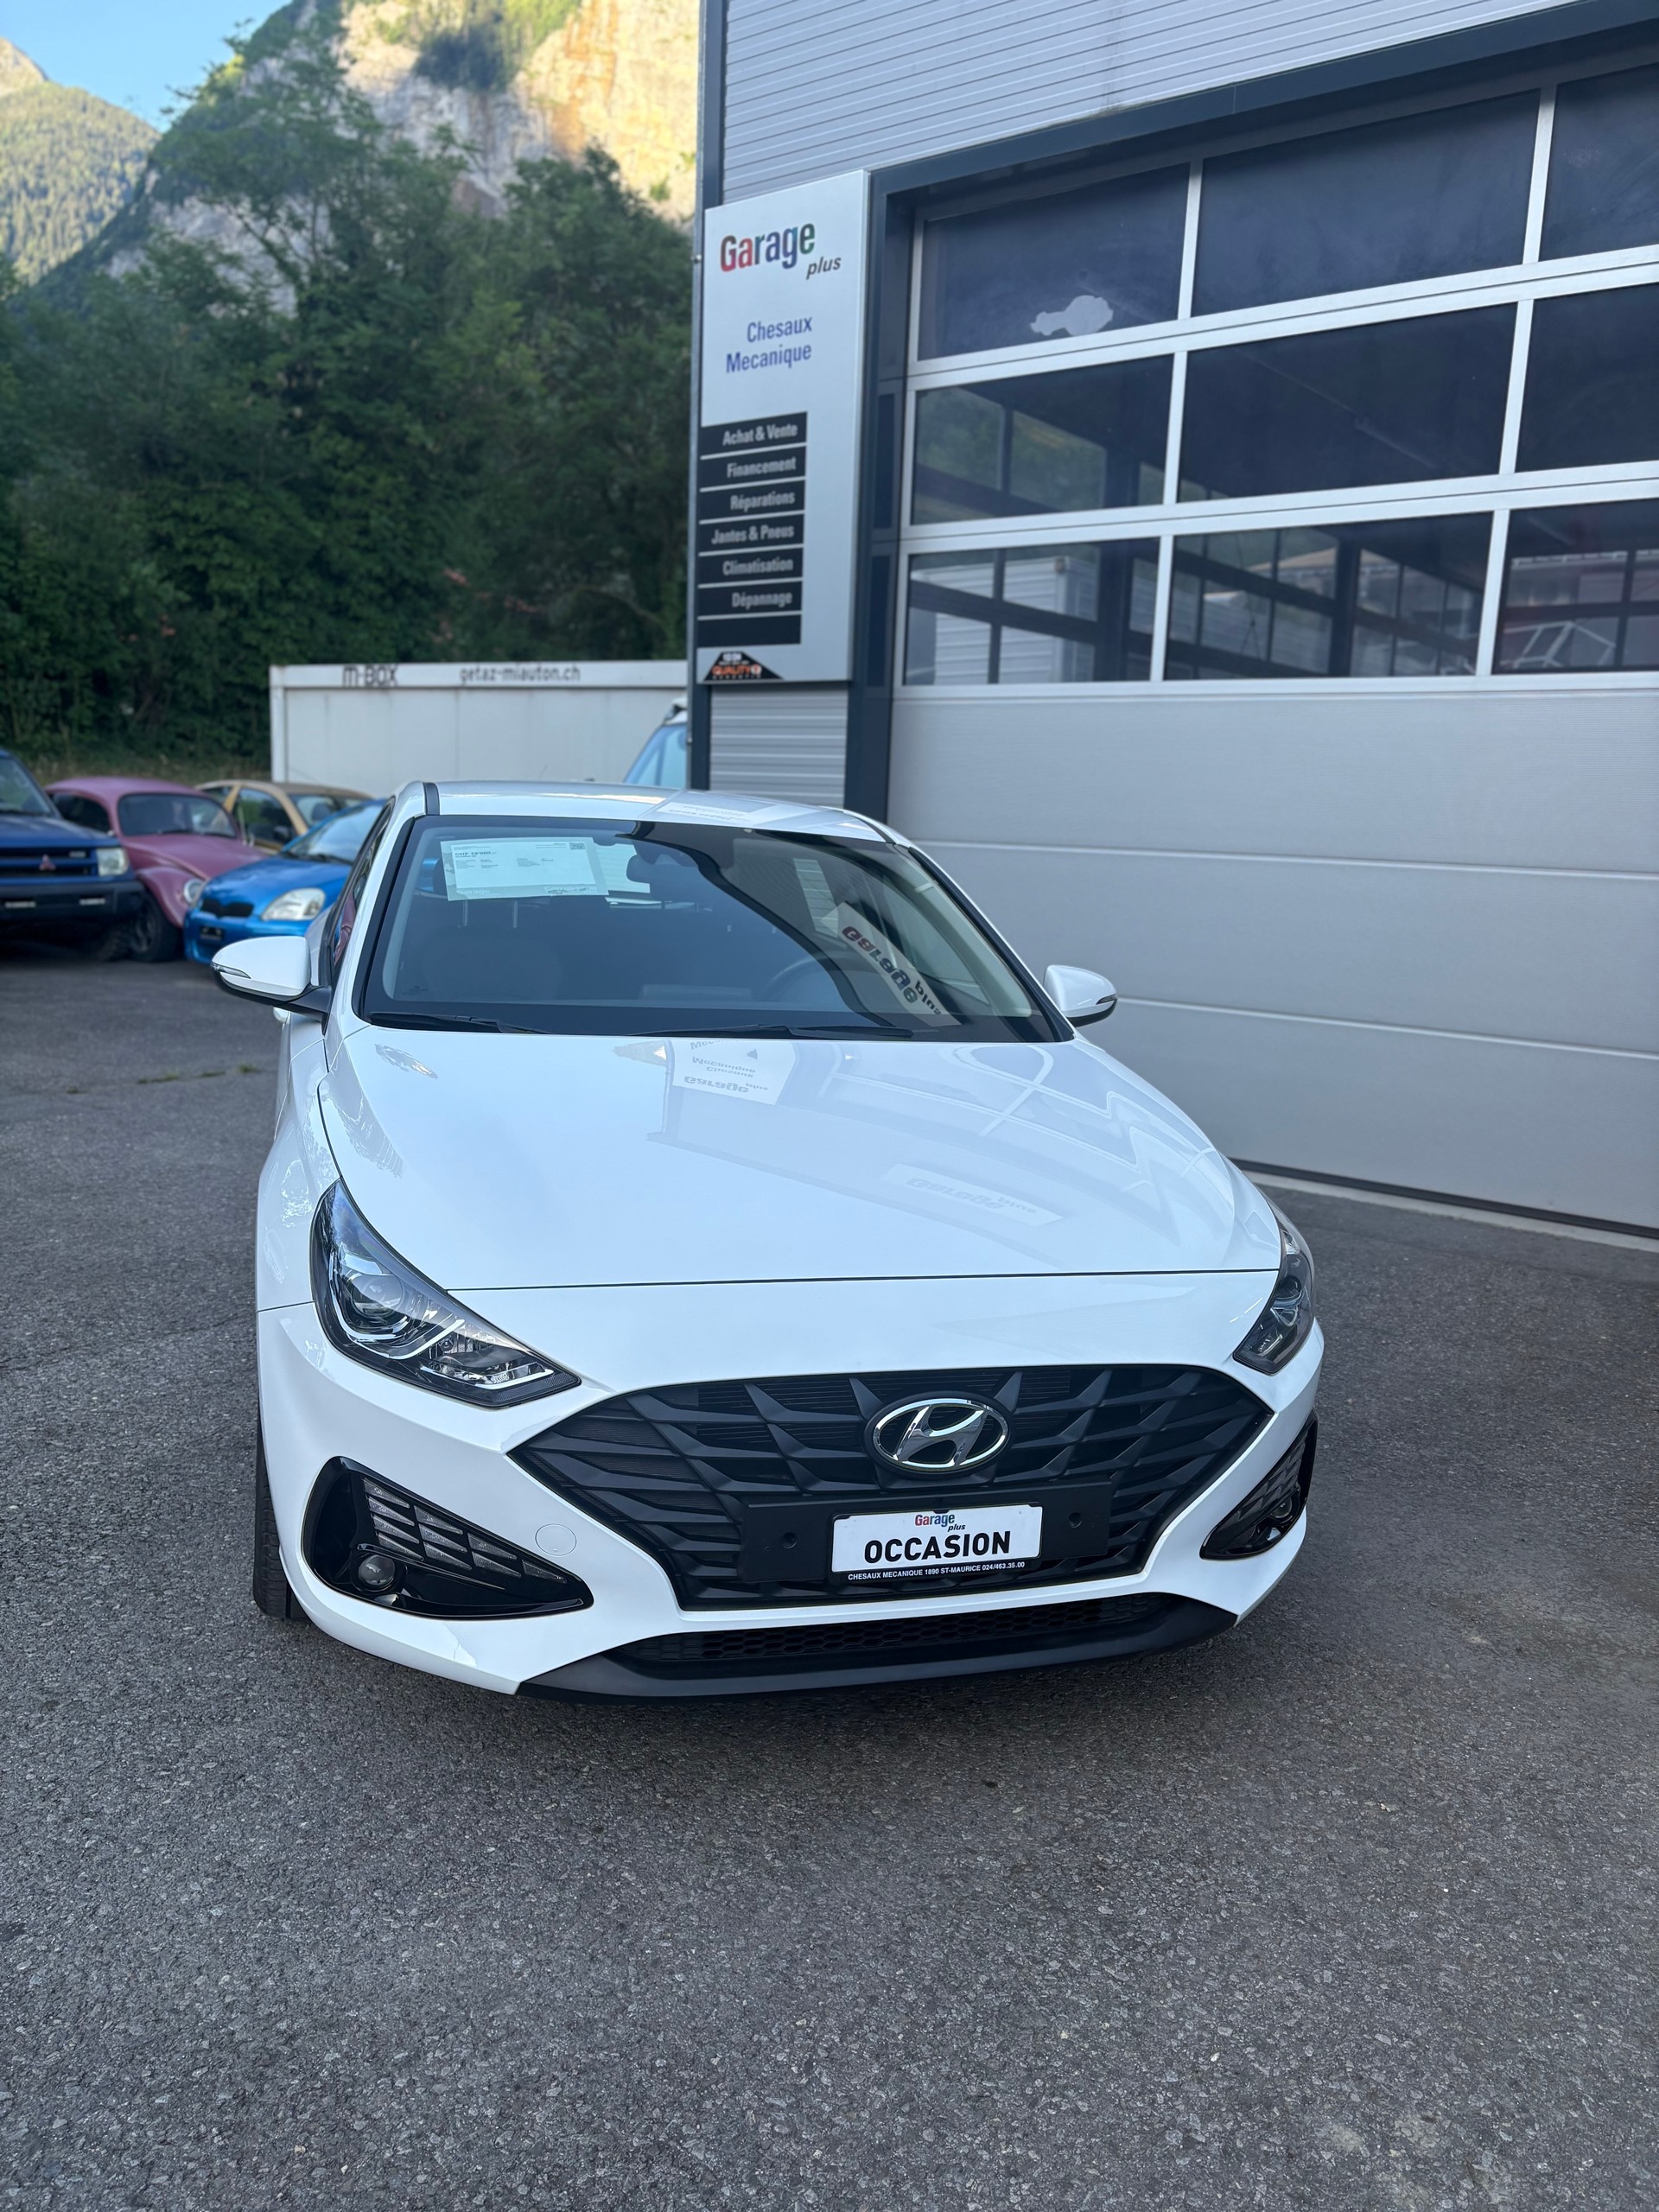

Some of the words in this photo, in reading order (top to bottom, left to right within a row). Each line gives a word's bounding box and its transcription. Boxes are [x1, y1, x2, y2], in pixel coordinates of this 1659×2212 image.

[720, 223, 815, 272] Garage
[805, 257, 842, 280] plus
[747, 316, 813, 343] Chesaux
[726, 344, 811, 373] Mecanique
[722, 428, 754, 447] Achat
[755, 426, 766, 442] &
[766, 423, 798, 440] Vente
[726, 456, 797, 479] Financement
[730, 490, 796, 512] Réparations
[710, 529, 747, 544] Jantes
[748, 525, 759, 541] &
[760, 524, 795, 540] Pneus
[722, 556, 794, 576] Climatisation
[731, 591, 793, 611] Dépannage
[914, 1513, 956, 1528] Garage
[947, 1523, 966, 1533] plus
[863, 1530, 1011, 1564] OCCASION
[848, 1571, 881, 1580] CHESAUX
[882, 1569, 924, 1579] MECANIQUE
[925, 1567, 940, 1576] 1890
[940, 1564, 982, 1574] ST-MAURICE
[982, 1561, 1026, 1572] 024/463.35.00
